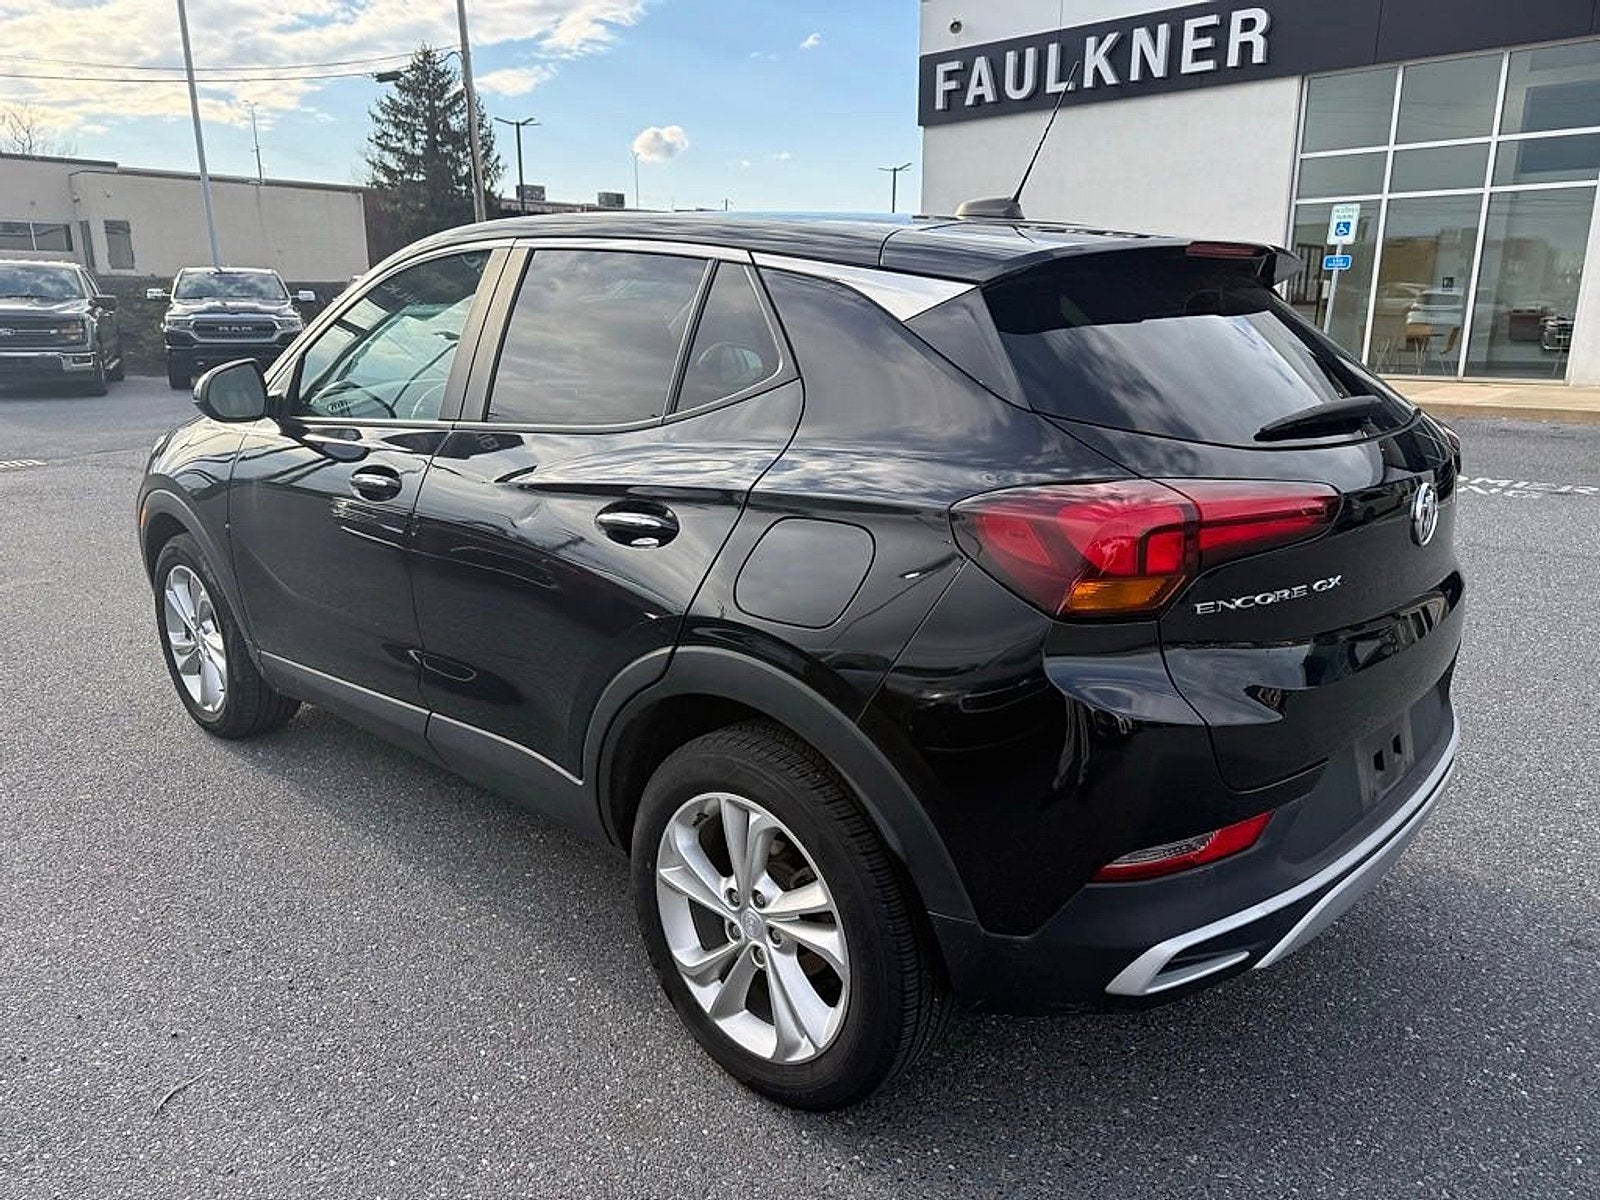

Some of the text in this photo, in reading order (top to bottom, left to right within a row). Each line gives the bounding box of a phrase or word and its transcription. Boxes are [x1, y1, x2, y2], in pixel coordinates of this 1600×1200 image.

[934, 8, 1271, 111] FAULKNER
[217, 325, 253, 333] RAM
[1194, 574, 1343, 615] ENCORE GX
